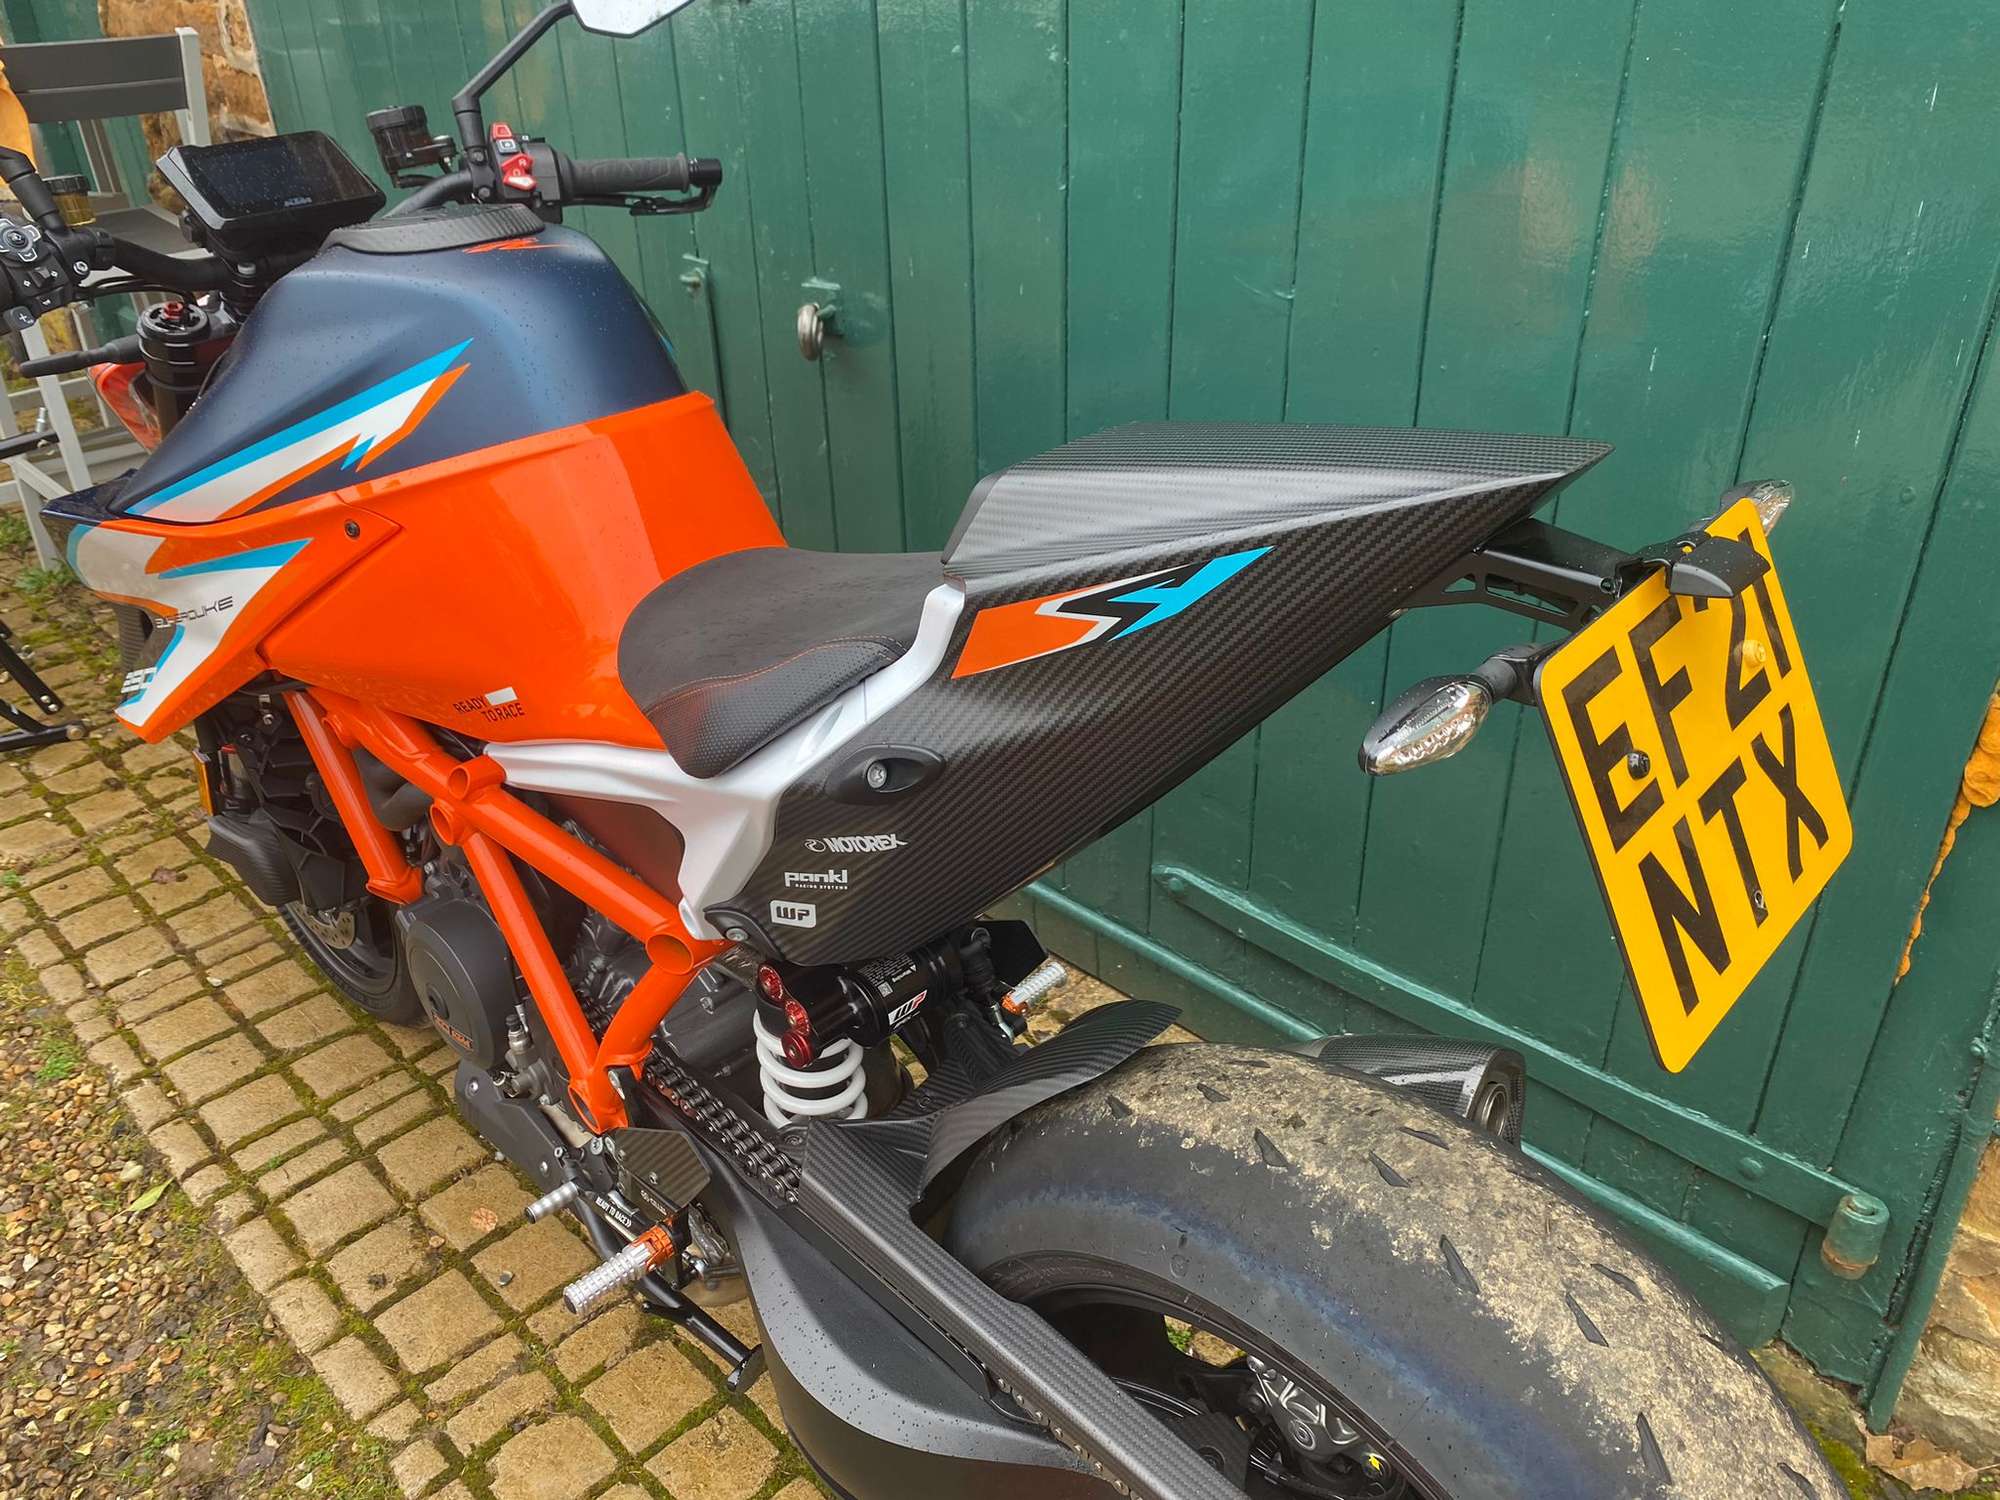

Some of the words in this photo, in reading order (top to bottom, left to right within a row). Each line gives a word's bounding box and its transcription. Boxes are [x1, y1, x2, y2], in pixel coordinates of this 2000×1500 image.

[1562, 527, 1792, 854] EF21
[453, 696, 487, 713] READY
[481, 708, 498, 722] TO
[495, 702, 525, 721] RACE
[823, 833, 908, 853] MOTOREX
[1638, 702, 1829, 1017] NTX
[784, 869, 848, 888] pankl
[776, 906, 810, 921] WP
